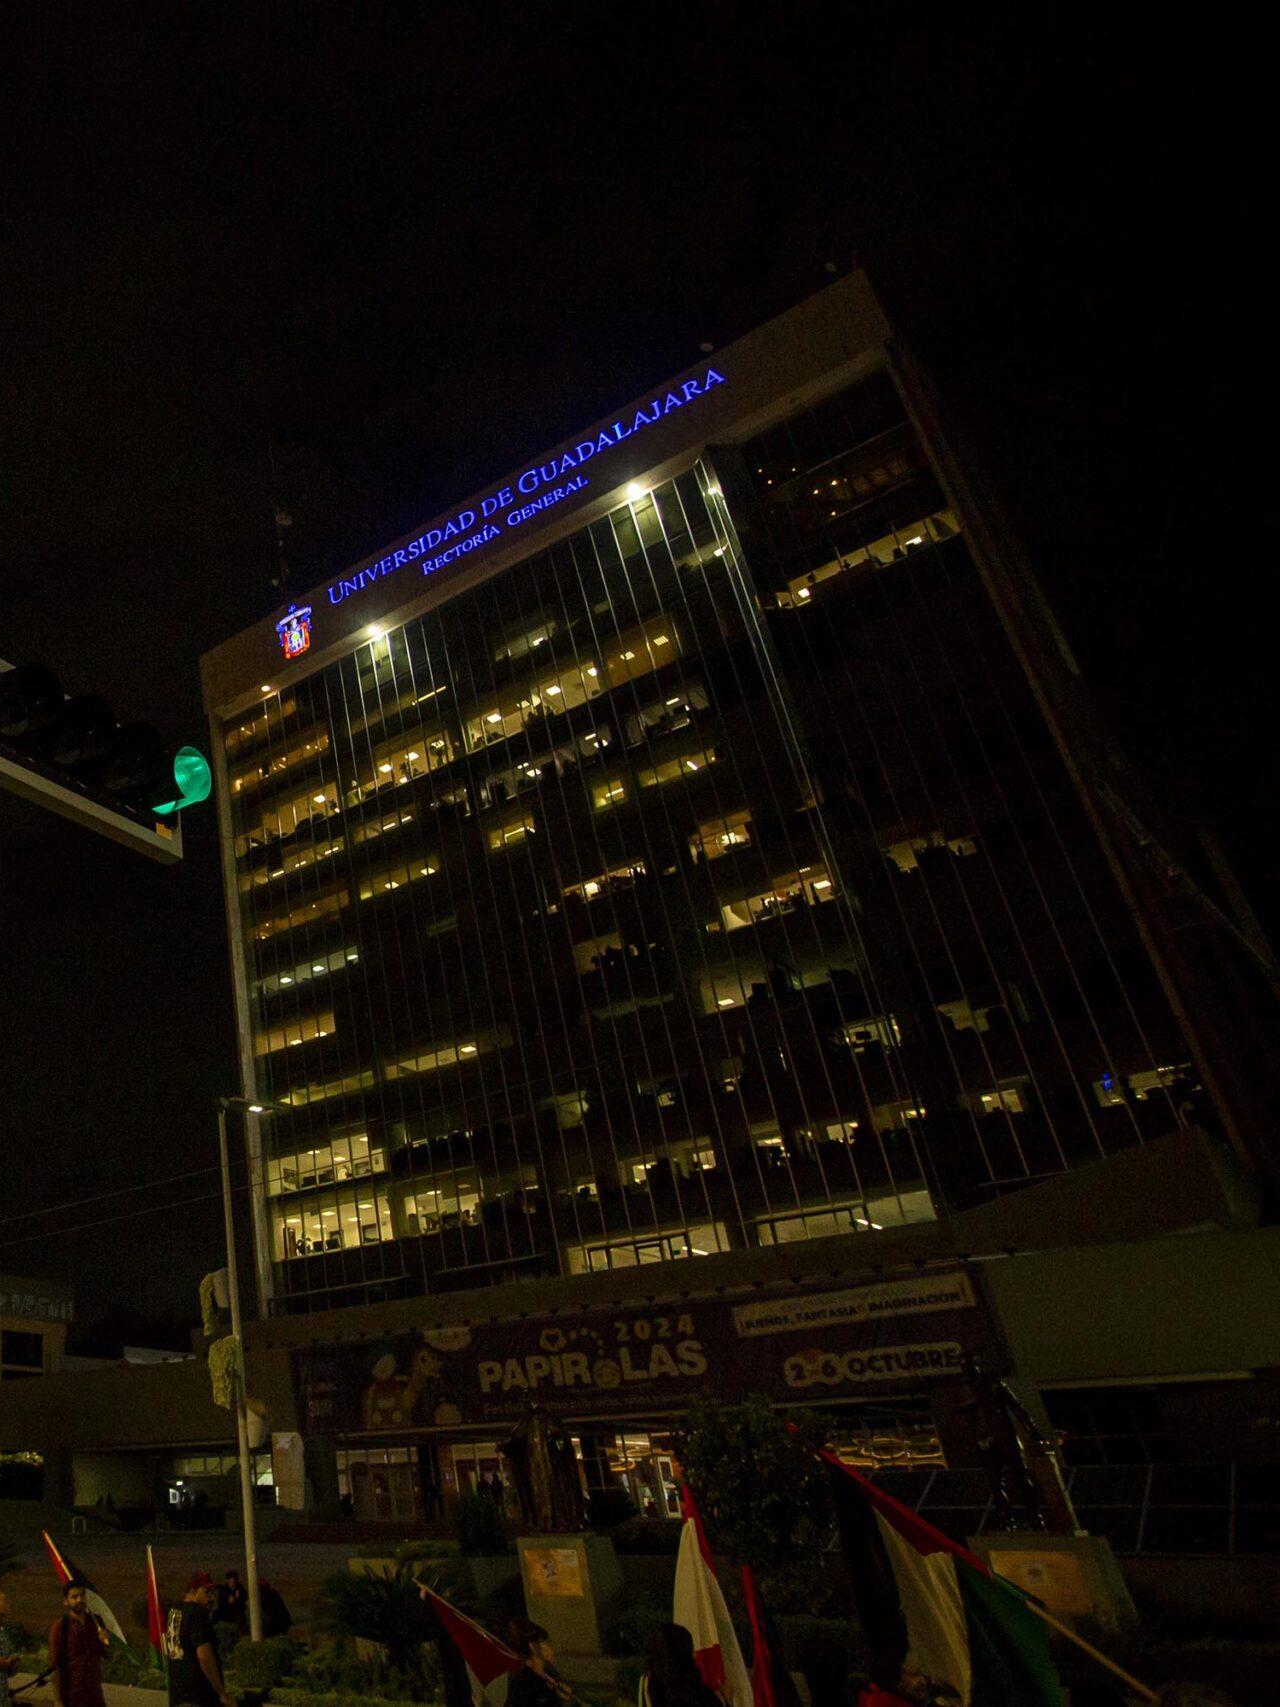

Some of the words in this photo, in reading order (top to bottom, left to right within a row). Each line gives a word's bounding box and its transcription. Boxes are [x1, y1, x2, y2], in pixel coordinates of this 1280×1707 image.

[327, 510, 475, 606] UNIVERSIDAD
[481, 486, 515, 518] DE
[517, 366, 726, 496] GUADALAJARA
[421, 523, 501, 577] RECTORÍA
[506, 474, 591, 527] GENERAL
[614, 1313, 695, 1342] 2024
[847, 1348, 958, 1376] OCTUBRE
